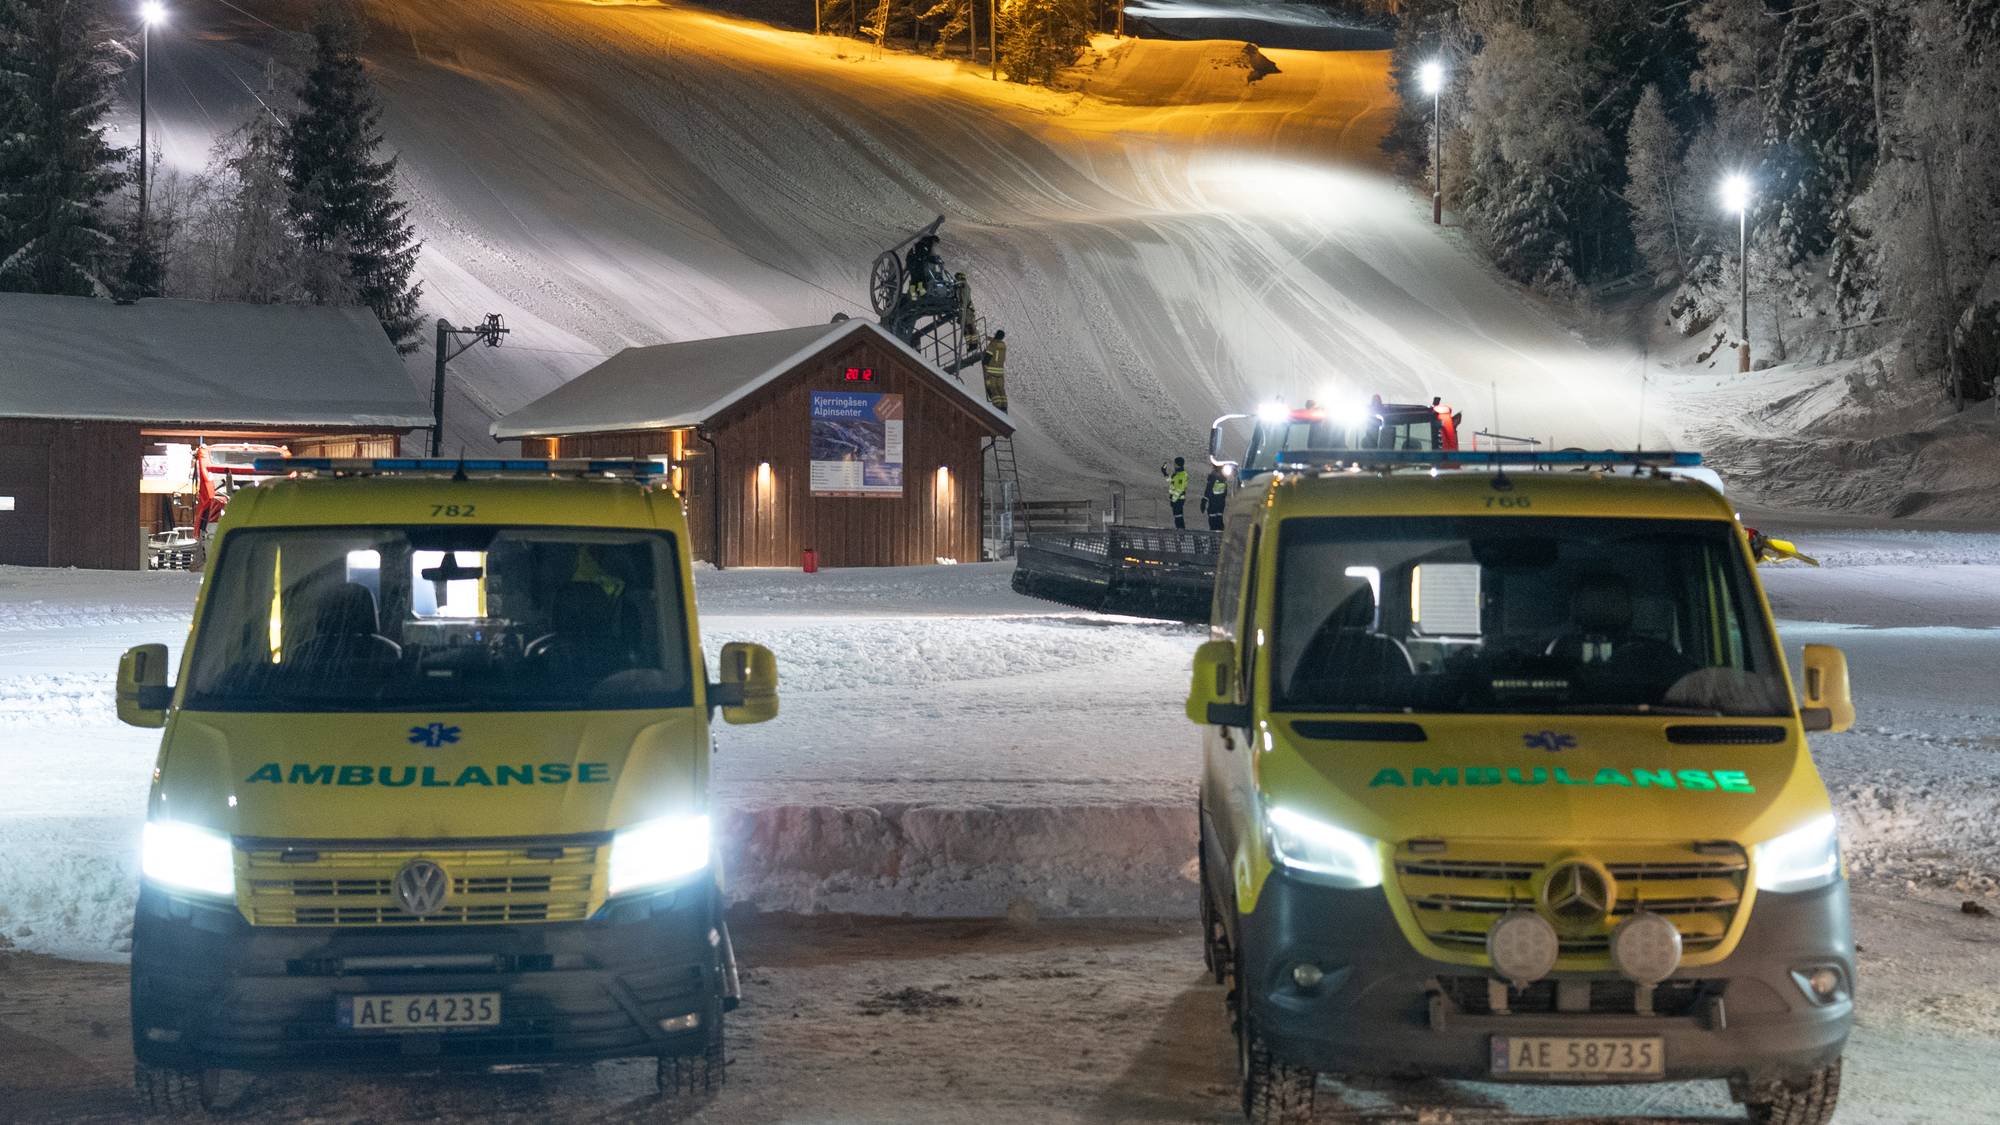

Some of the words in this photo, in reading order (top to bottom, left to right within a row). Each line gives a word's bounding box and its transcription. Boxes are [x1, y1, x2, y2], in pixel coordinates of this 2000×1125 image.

[814, 396, 868, 407] Kjerringåsen
[814, 407, 862, 417] Alpinsenter
[430, 504, 475, 518] 782
[1482, 496, 1531, 508] 766
[245, 762, 611, 787] AMBULANSE
[1367, 766, 1757, 793] AMBULANSE
[360, 999, 393, 1025] AE
[407, 997, 492, 1023] 64235
[1518, 1043, 1551, 1068] AE
[1567, 1042, 1653, 1068] 58735
